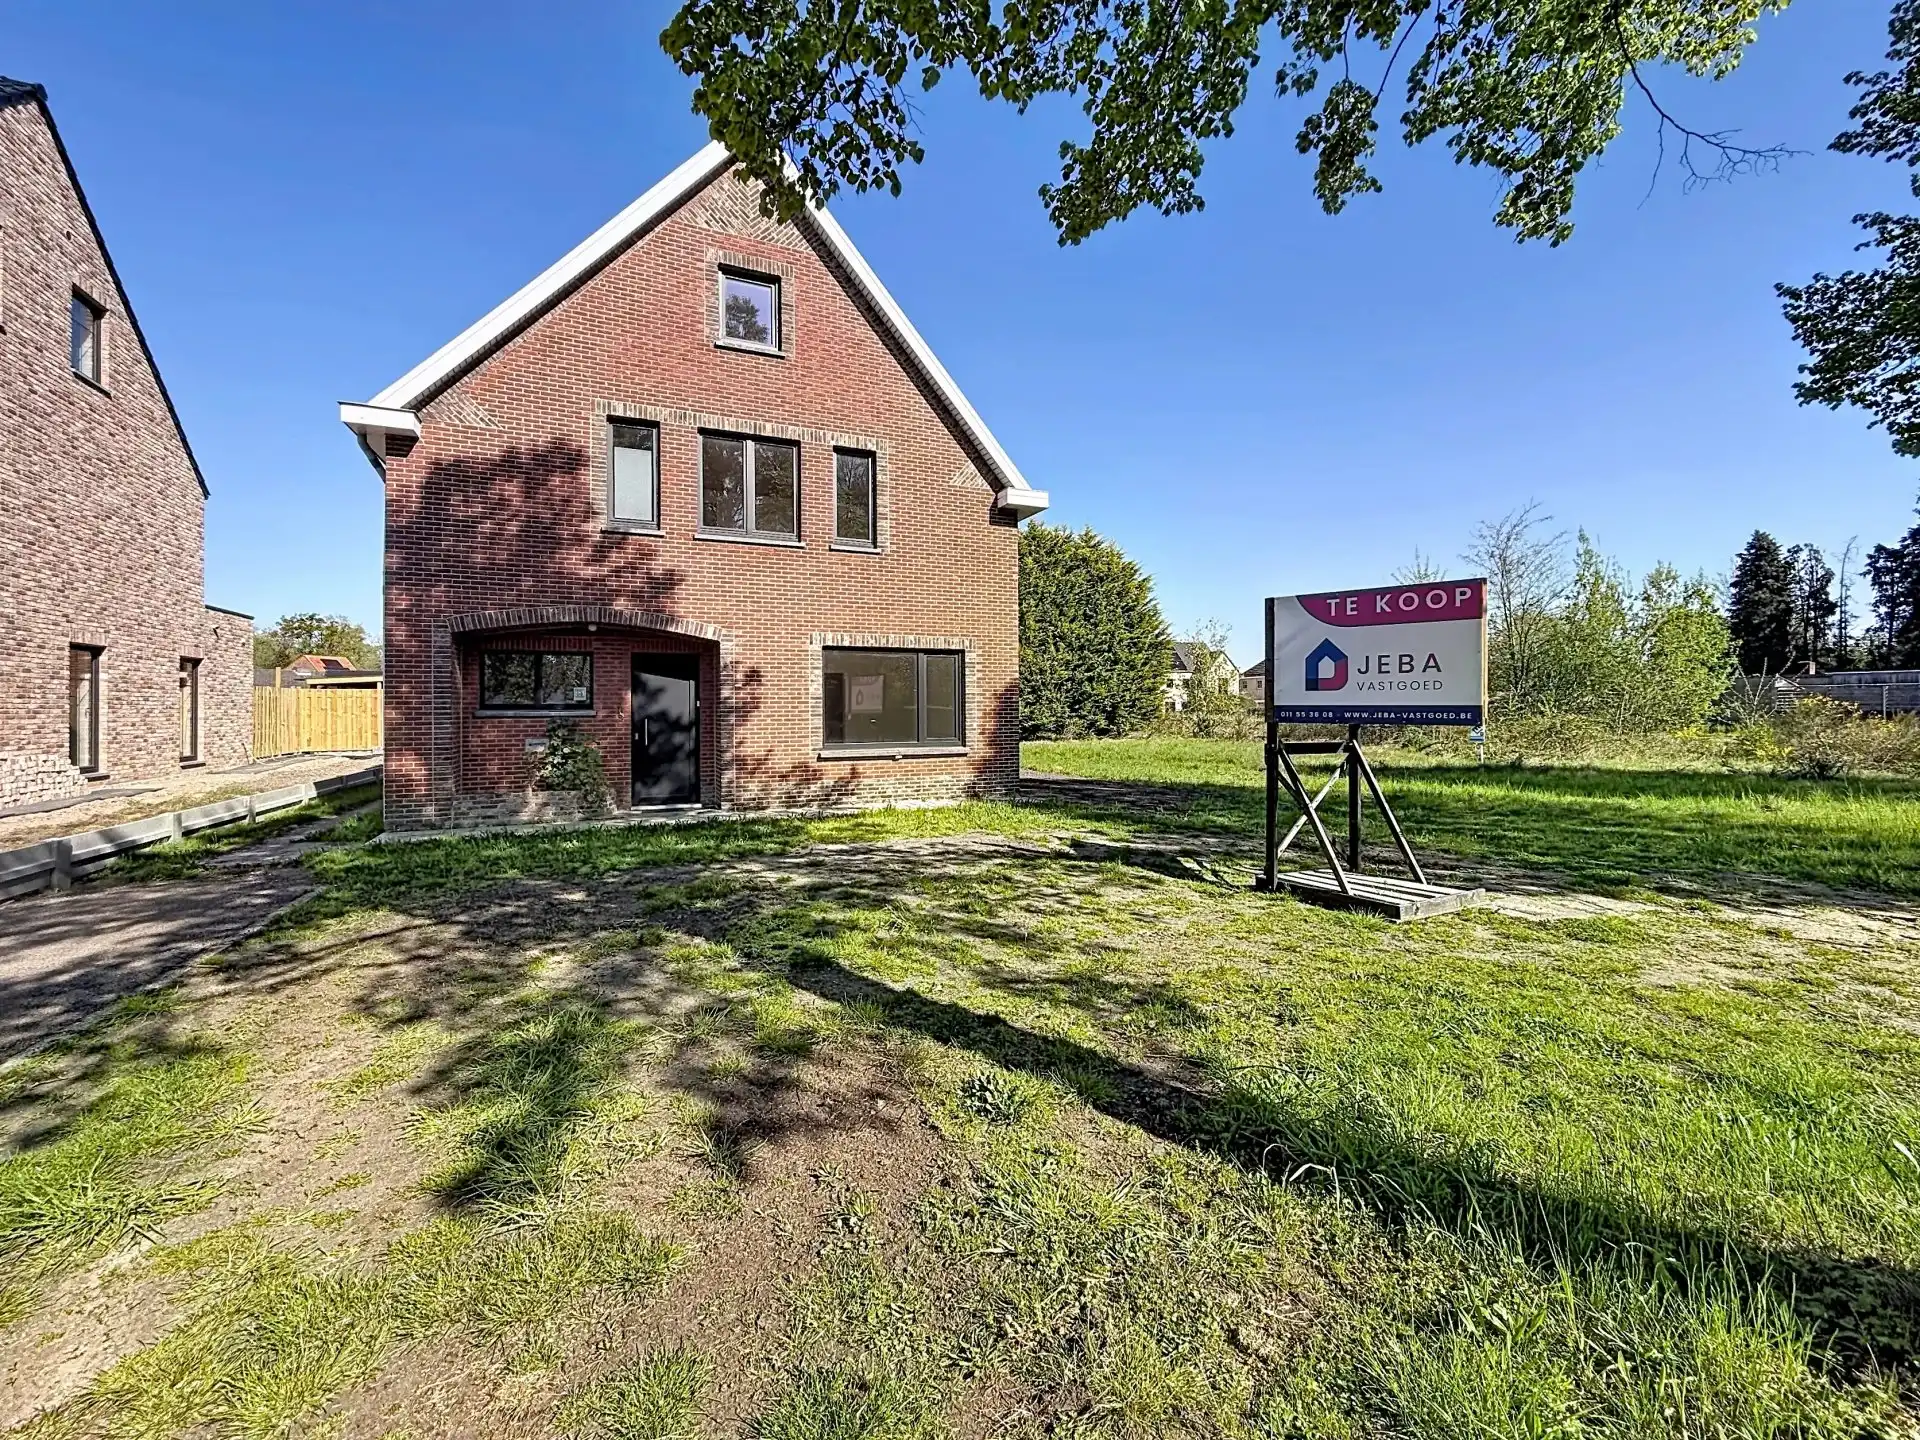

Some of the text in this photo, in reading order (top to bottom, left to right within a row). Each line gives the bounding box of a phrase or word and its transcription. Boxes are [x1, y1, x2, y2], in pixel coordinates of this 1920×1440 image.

[1326, 587, 1472, 617] TE KOOP
[1357, 653, 1442, 675] JEBA
[1356, 680, 1443, 691] VASTGOED
[1343, 711, 1473, 720] WWW.JEBA-VASTGOED.BE
